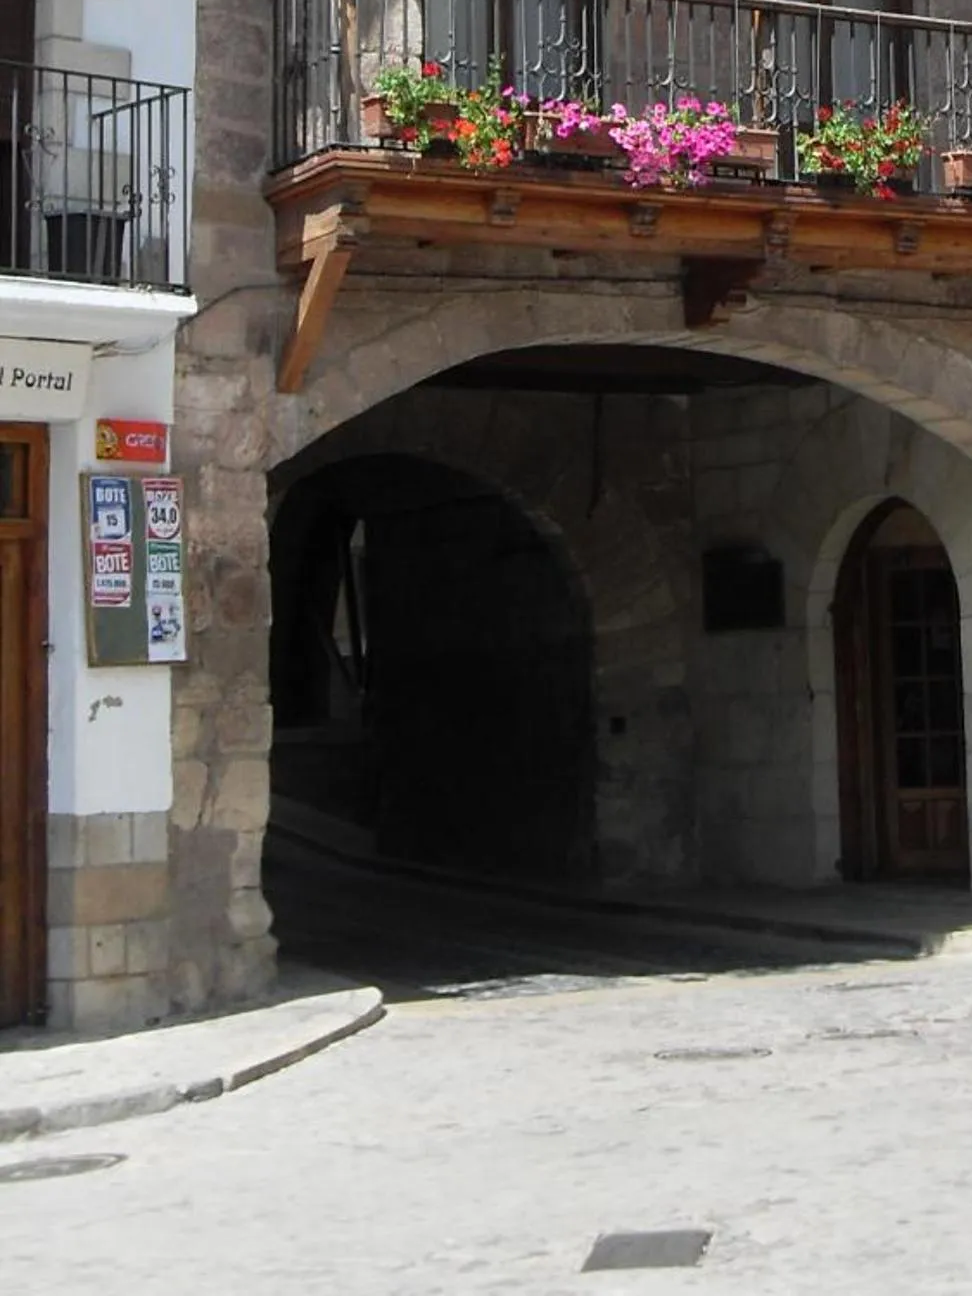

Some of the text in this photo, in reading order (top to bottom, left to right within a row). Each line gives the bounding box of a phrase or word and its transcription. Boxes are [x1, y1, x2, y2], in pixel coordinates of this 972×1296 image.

[11, 368, 72, 391] Portal
[95, 487, 126, 504] BOTE
[96, 552, 129, 573] BOTE
[150, 552, 179, 571] BOTE
